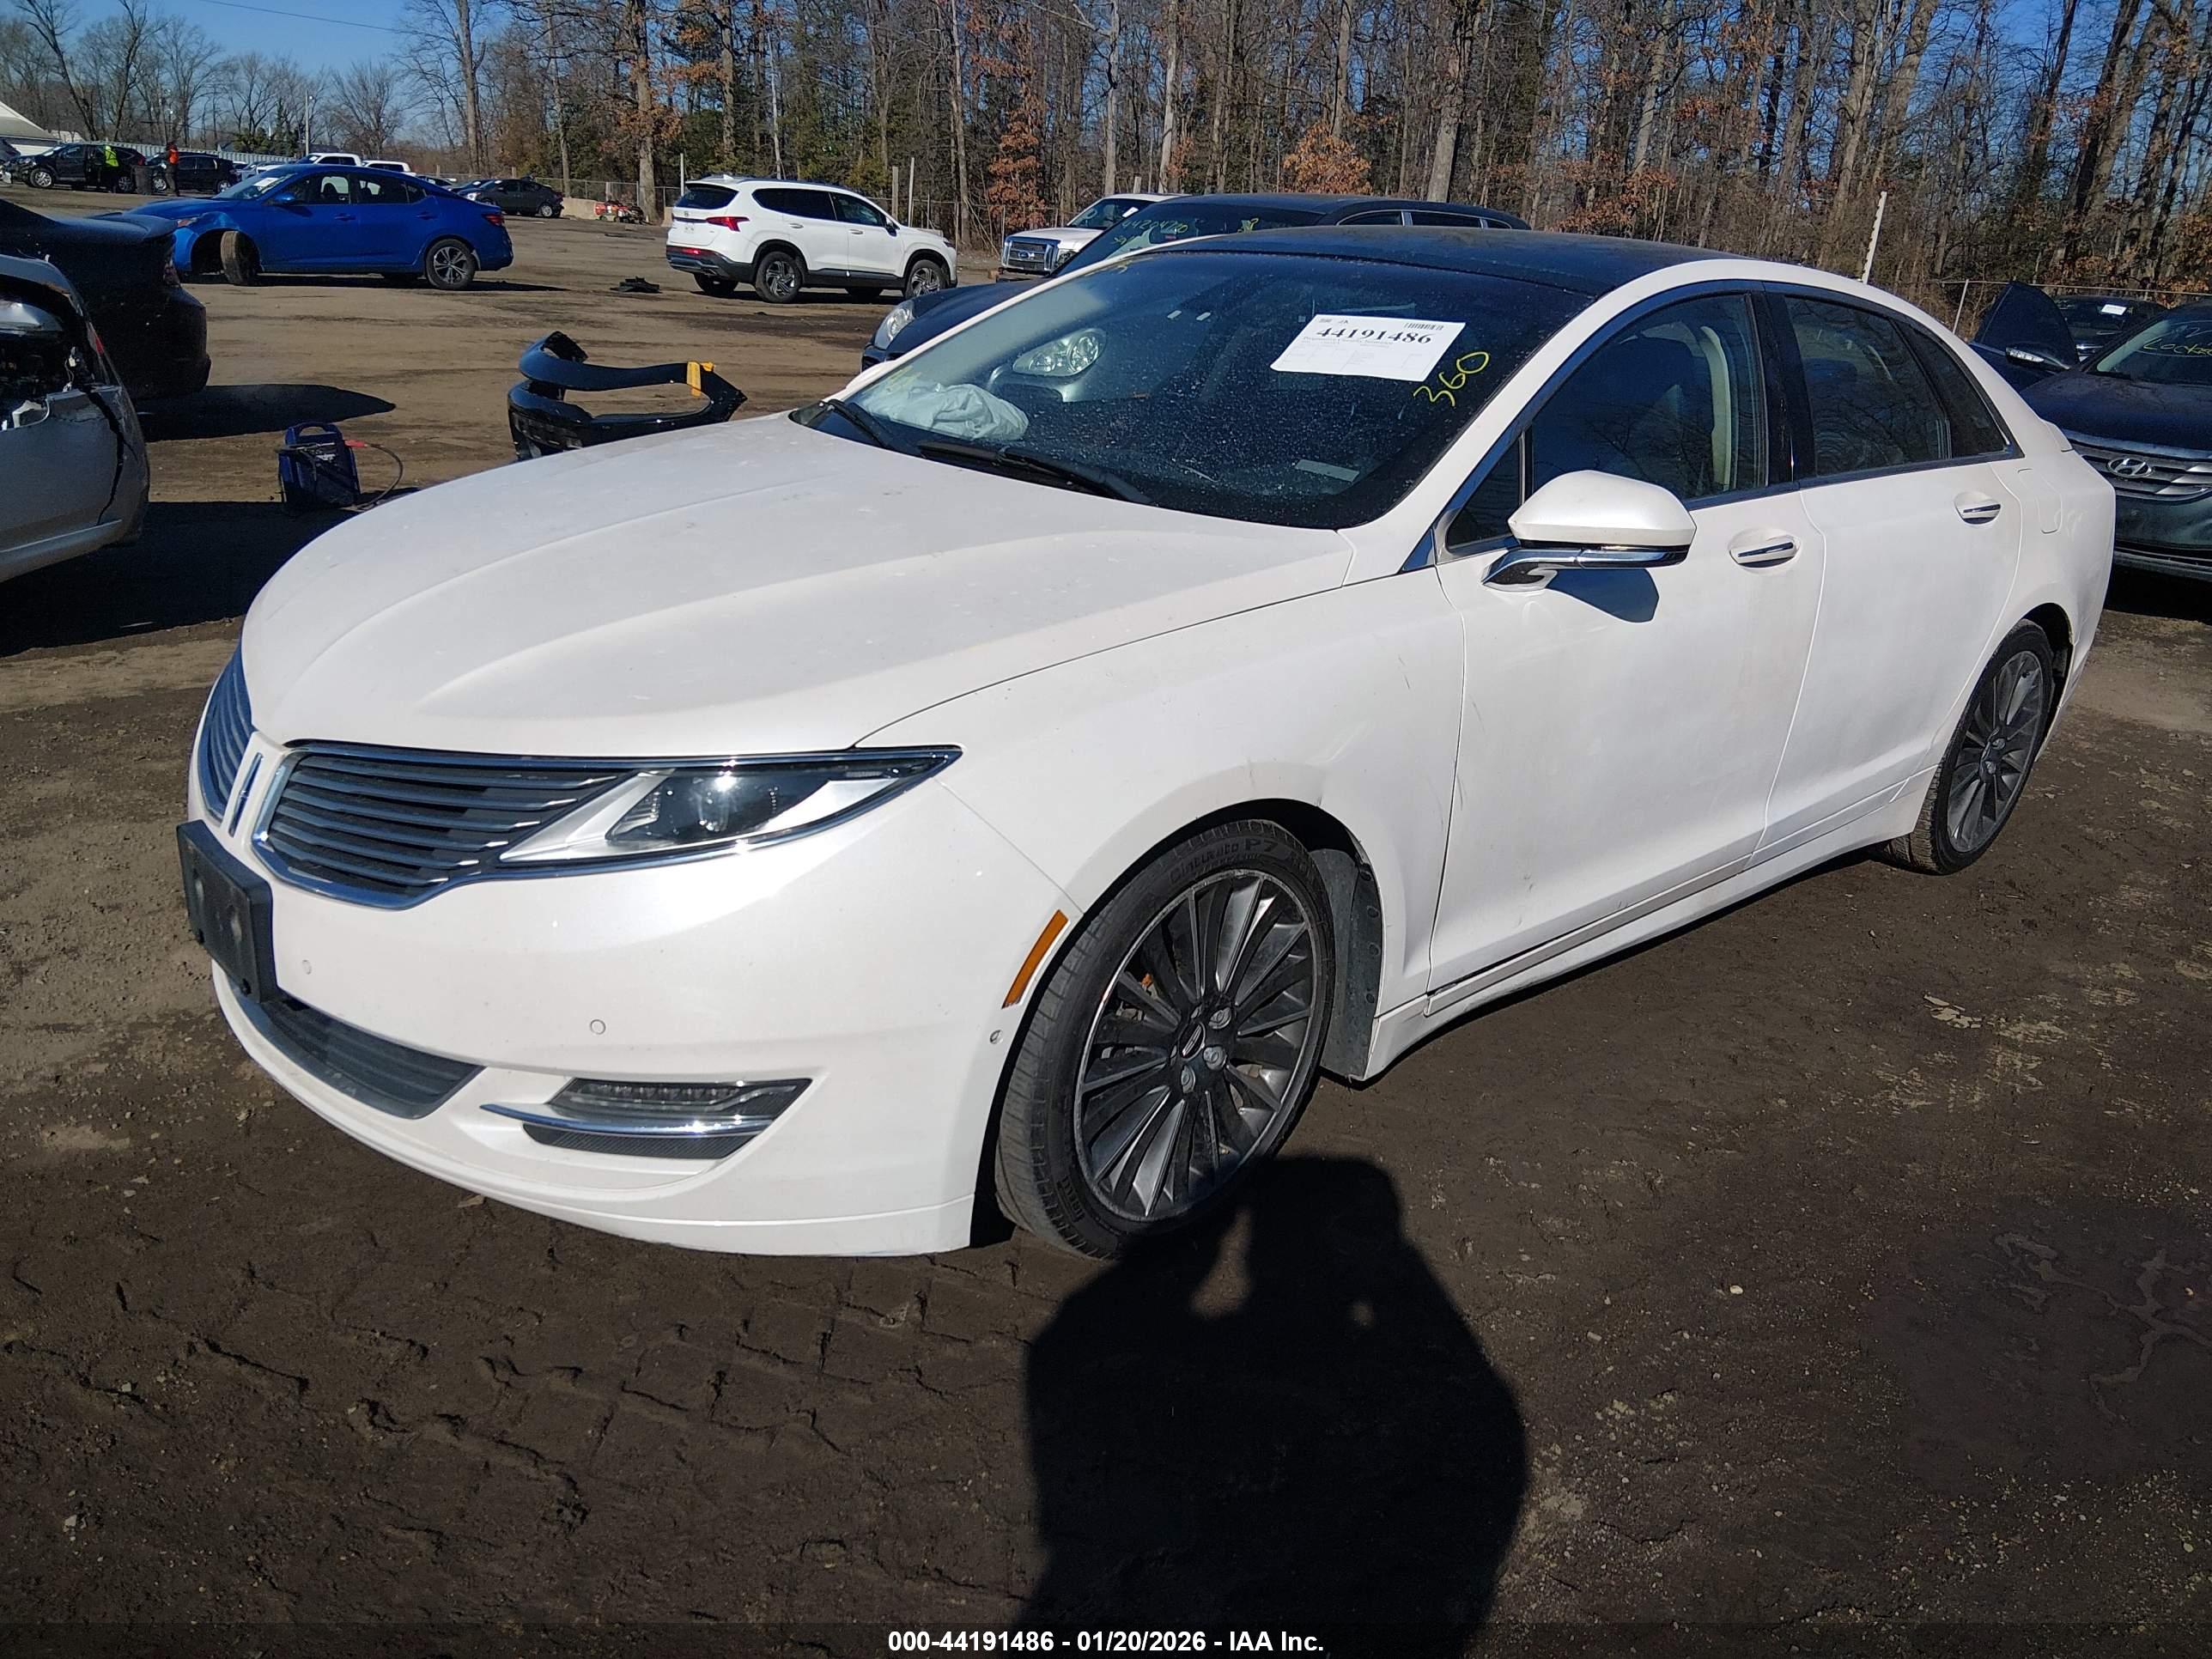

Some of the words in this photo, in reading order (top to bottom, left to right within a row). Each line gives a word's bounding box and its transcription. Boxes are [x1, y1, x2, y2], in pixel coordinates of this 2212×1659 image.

[1316, 327, 1435, 344] 44191486
[1413, 351, 1490, 407] 360
[1245, 838, 1279, 853] P7
